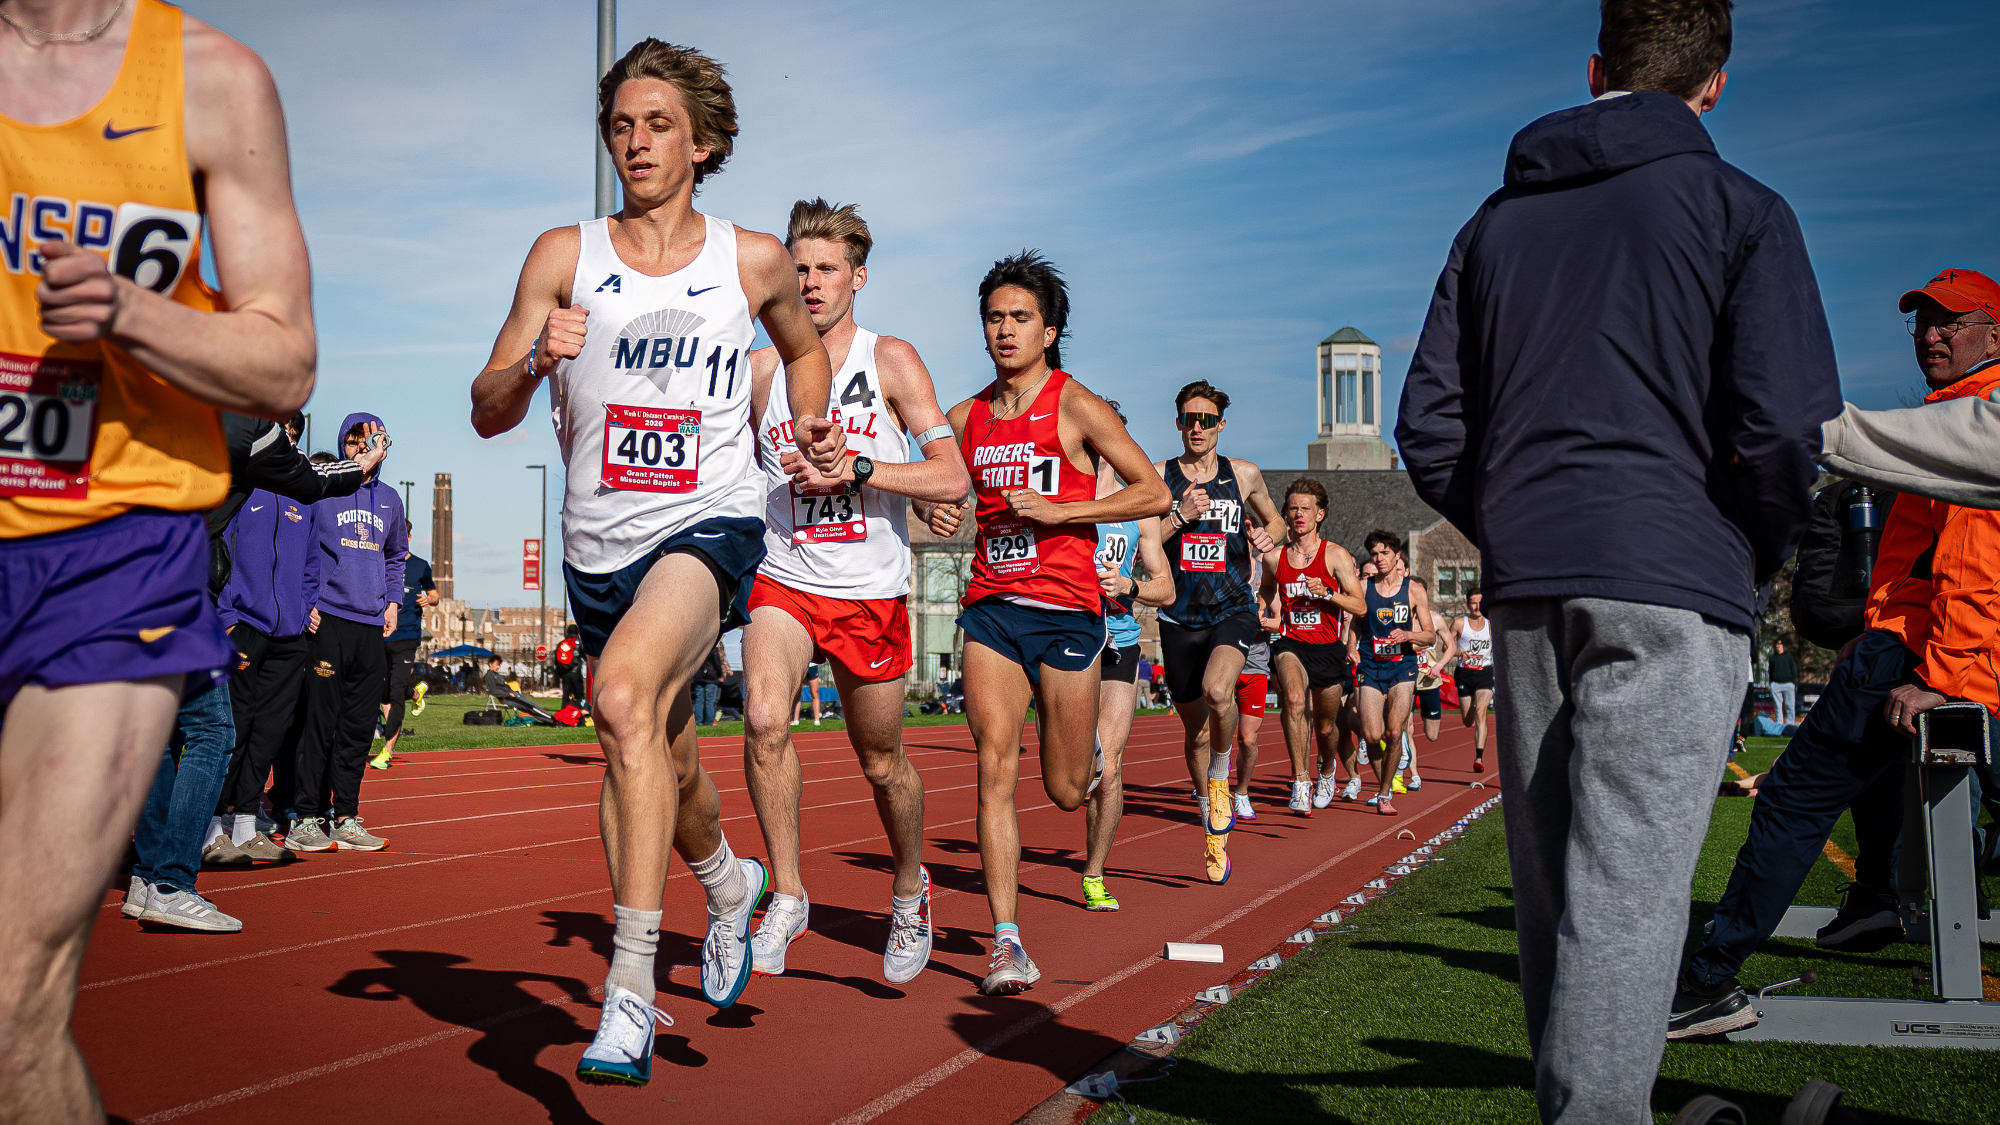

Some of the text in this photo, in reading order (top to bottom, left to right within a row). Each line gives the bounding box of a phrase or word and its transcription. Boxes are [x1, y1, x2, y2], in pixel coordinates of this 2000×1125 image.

[116, 218, 189, 294] 6
[614, 336, 700, 370] MBU
[705, 345, 739, 400] 11
[840, 370, 876, 408] 4
[663, 412, 684, 421] Carnival
[679, 425, 700, 434] WASH
[616, 429, 686, 468] 403
[973, 442, 1035, 467] ROGERS
[620, 476, 681, 488] Missouri Baptist
[626, 469, 674, 480] Grant Patten
[982, 465, 1025, 488] STATE
[1032, 459, 1053, 492] 1
[336, 509, 384, 533] POINTERS
[801, 494, 854, 524] 743
[1224, 506, 1240, 531] 14
[340, 537, 358, 549] CROSS
[991, 535, 1029, 562] 529
[1105, 536, 1127, 562] 30
[1188, 544, 1220, 560] 102
[1293, 612, 1317, 624] 865
[1396, 606, 1408, 622] 12
[1378, 643, 1397, 655] 161
[1894, 1023, 1942, 1035] UCS
